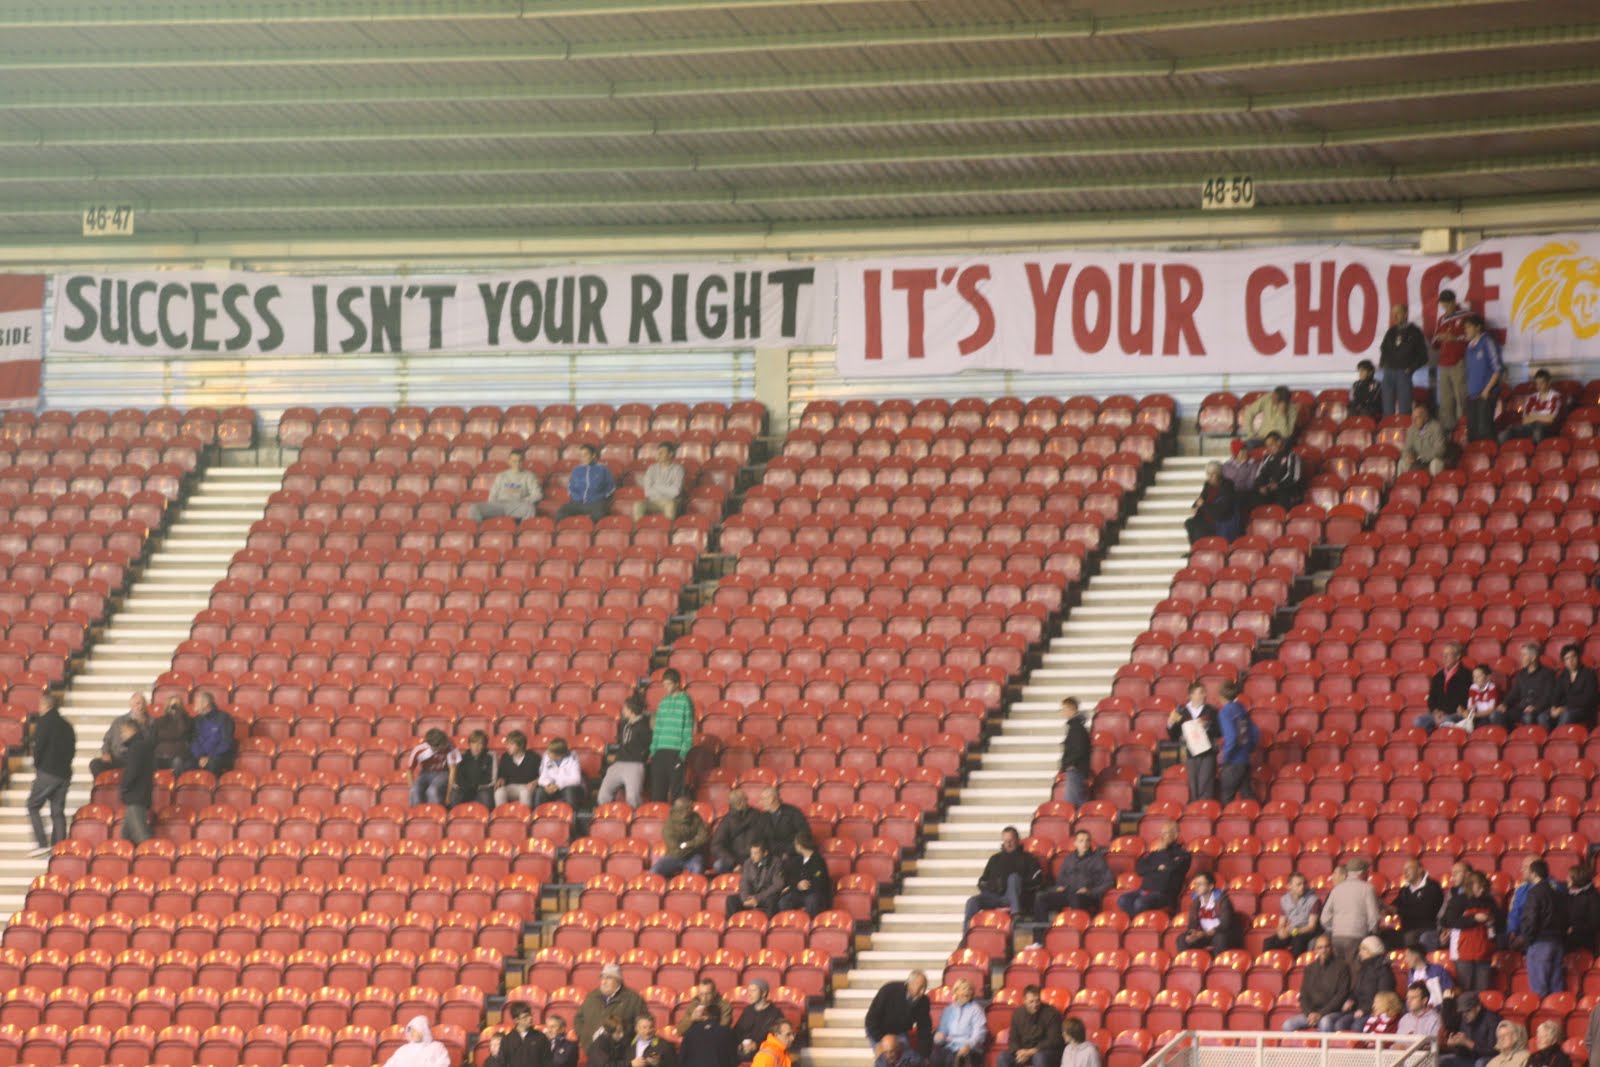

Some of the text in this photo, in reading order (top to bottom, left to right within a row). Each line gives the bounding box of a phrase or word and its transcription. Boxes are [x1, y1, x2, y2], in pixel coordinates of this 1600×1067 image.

[64, 267, 815, 353] SUCCESS ISN'T YOUR RIGHT
[863, 264, 996, 360] IT'S
[1024, 262, 1207, 356] YOUR
